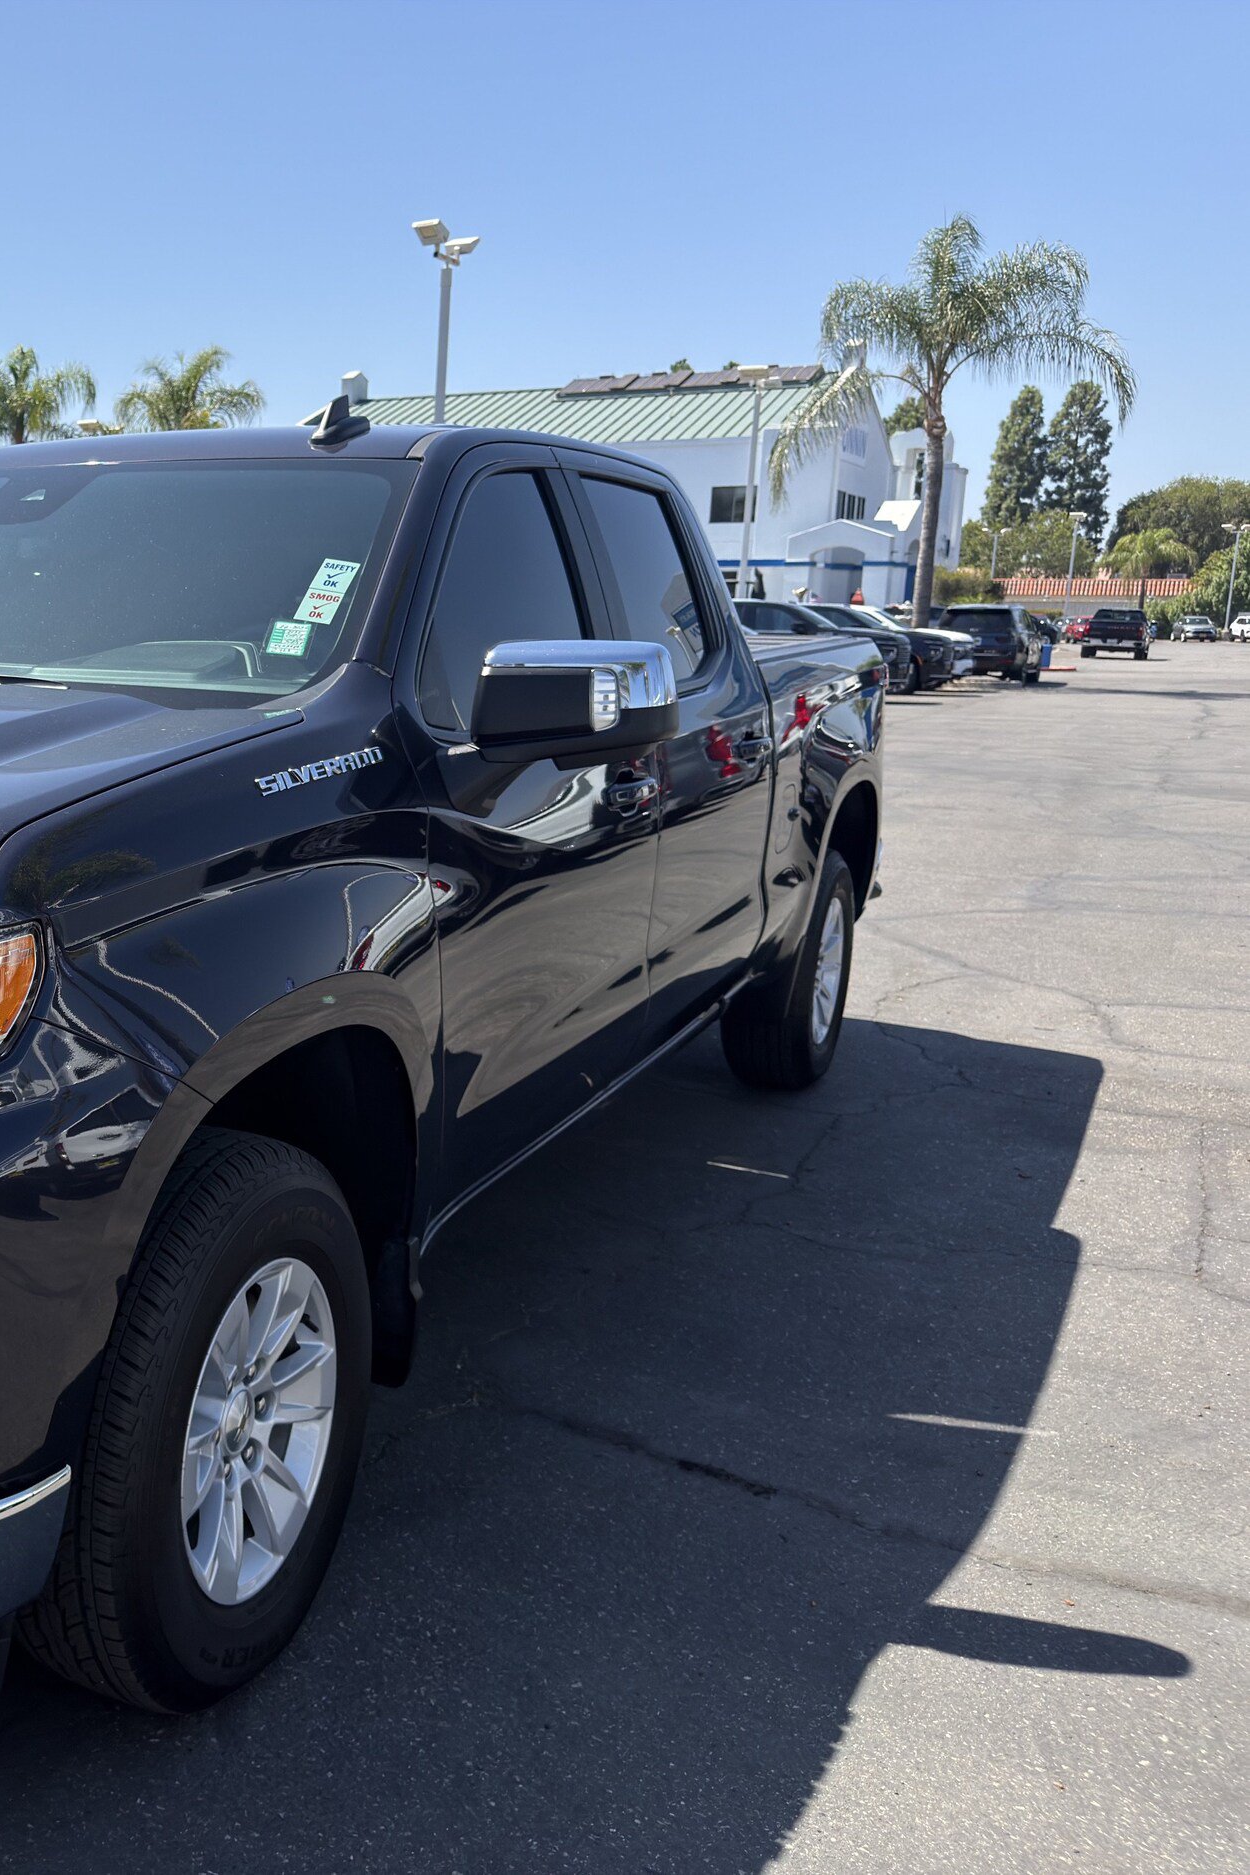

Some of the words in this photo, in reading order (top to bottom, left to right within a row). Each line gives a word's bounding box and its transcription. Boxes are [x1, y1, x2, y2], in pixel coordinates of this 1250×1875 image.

[323, 562, 356, 573] SAFETY
[323, 579, 339, 588] OK
[308, 592, 341, 603] SMOG
[308, 610, 324, 619] OK
[256, 746, 384, 796] SILVERADO
